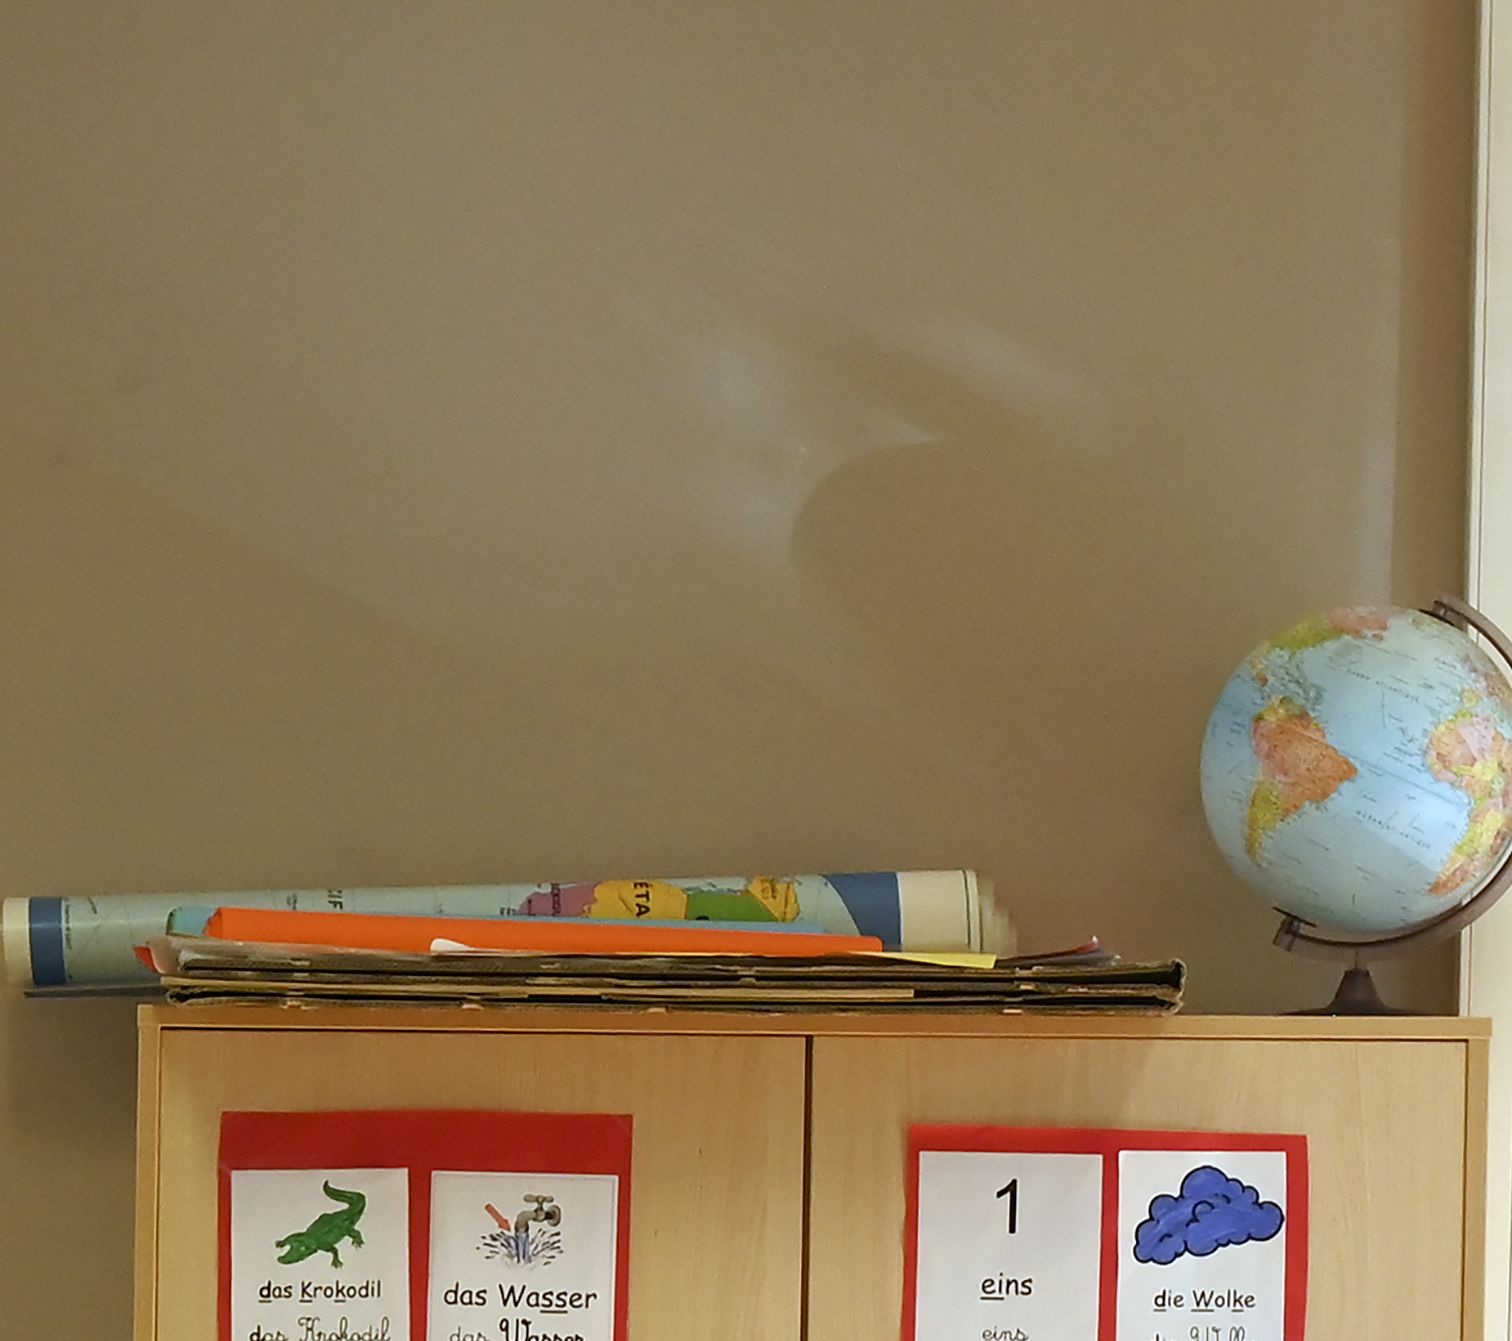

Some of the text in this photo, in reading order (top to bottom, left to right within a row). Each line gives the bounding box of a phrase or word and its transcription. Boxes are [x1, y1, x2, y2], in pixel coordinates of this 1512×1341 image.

[996, 1178, 1018, 1234] 1
[259, 1280, 381, 1300] das Krokodil
[444, 1283, 597, 1310] das Wasser
[981, 1272, 1033, 1297] eins
[1153, 1289, 1256, 1310] die Wolke
